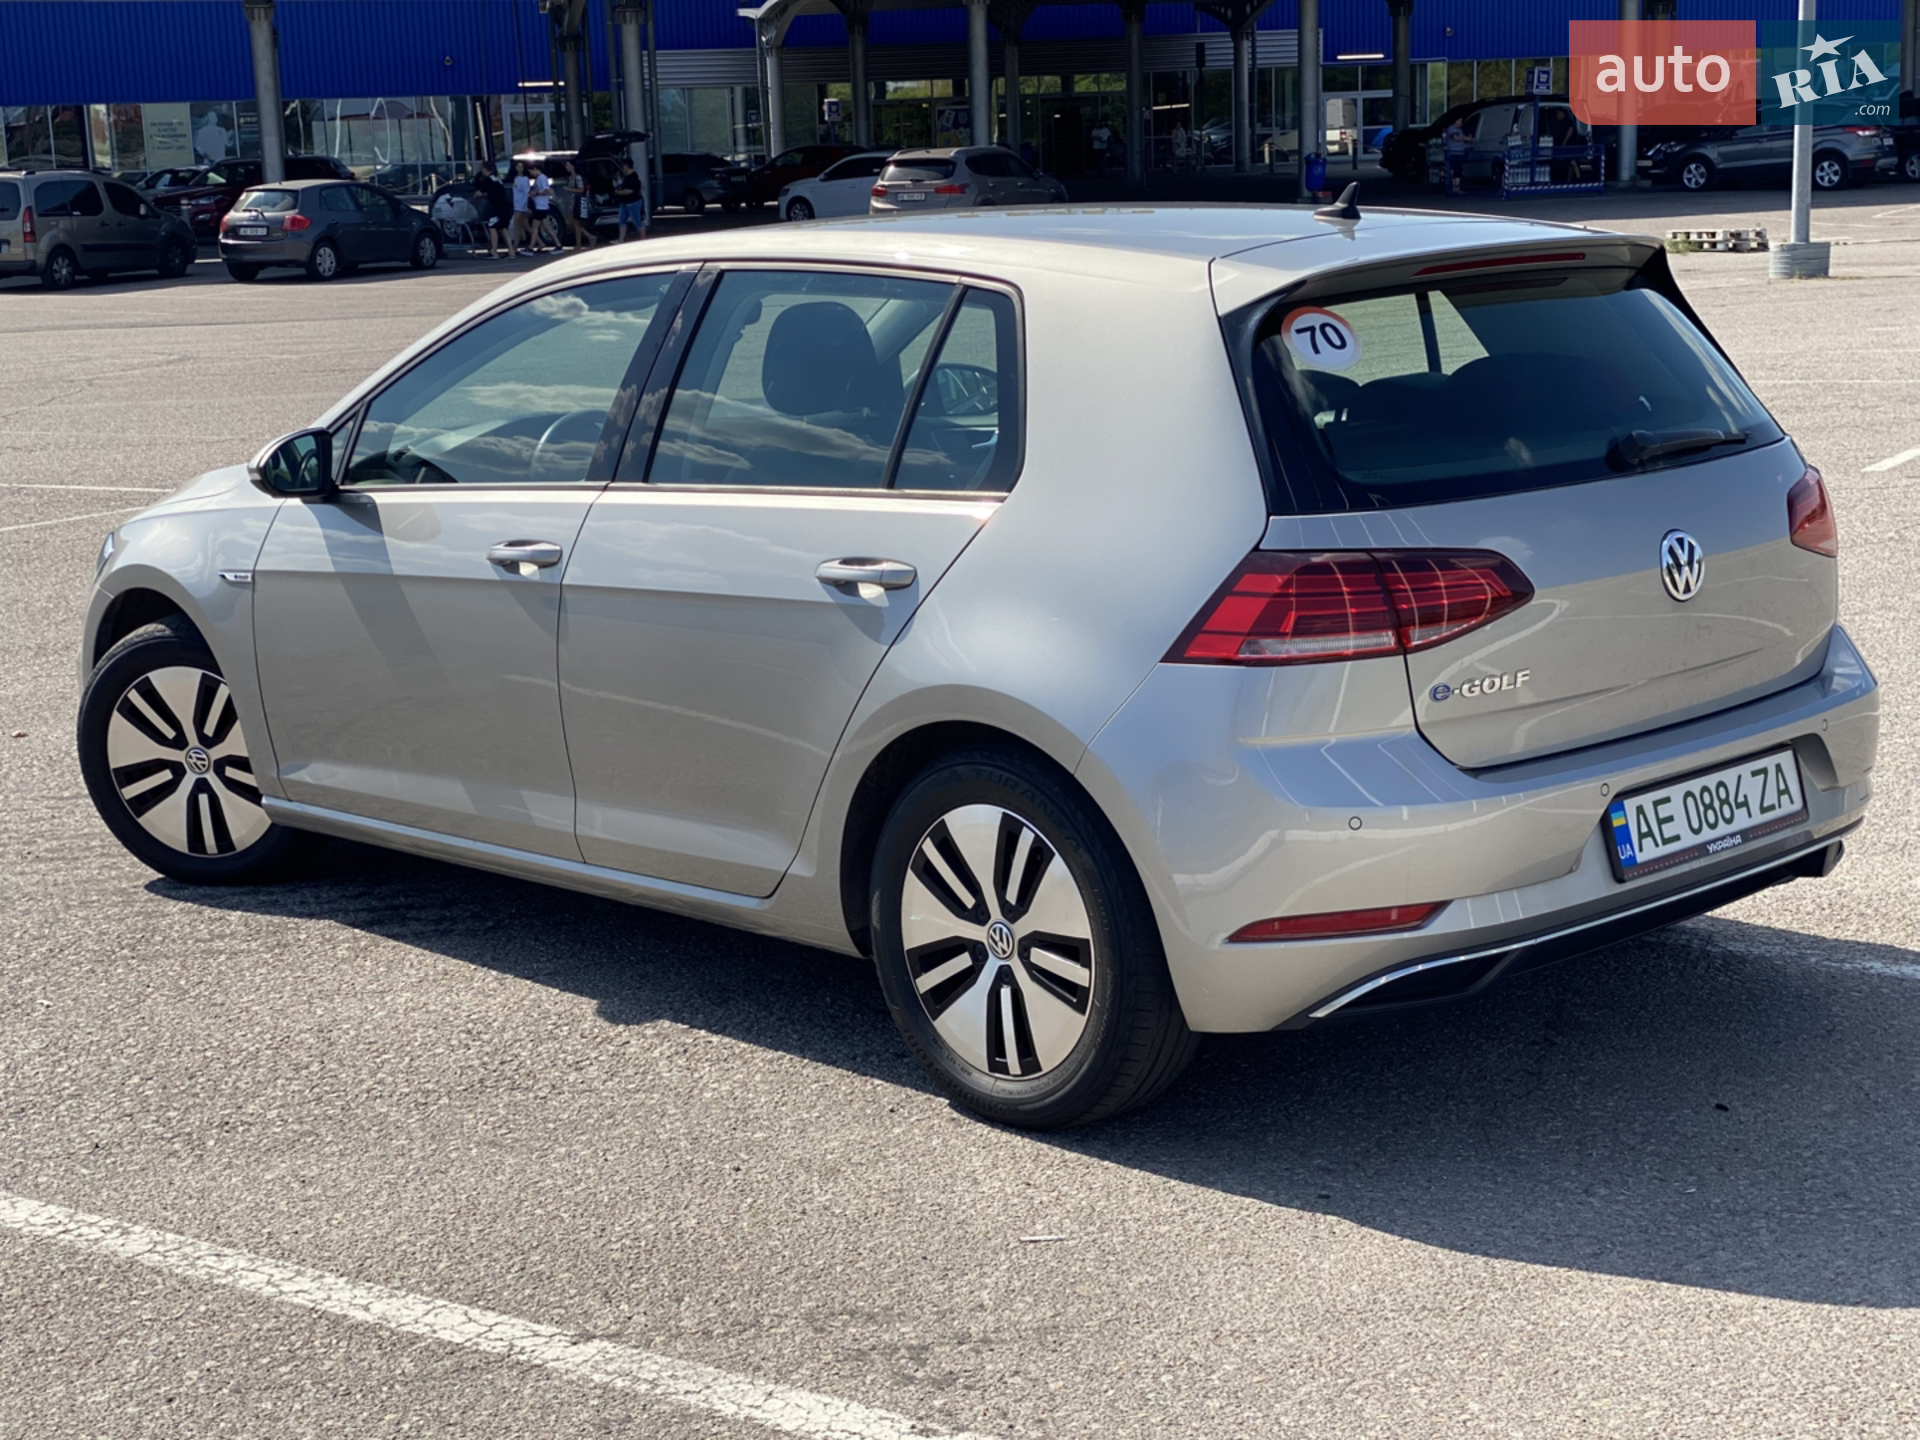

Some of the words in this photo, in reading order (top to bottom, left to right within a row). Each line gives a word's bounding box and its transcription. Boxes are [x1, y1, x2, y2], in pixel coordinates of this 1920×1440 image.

[1294, 322, 1347, 355] 70
[1429, 668, 1531, 703] e-GOLF
[1635, 796, 1681, 853] AE
[1683, 774, 1752, 836] 0884
[1751, 763, 1794, 815] ZA
[1617, 843, 1634, 860] UA
[1706, 834, 1742, 854] УКРАЇНА
